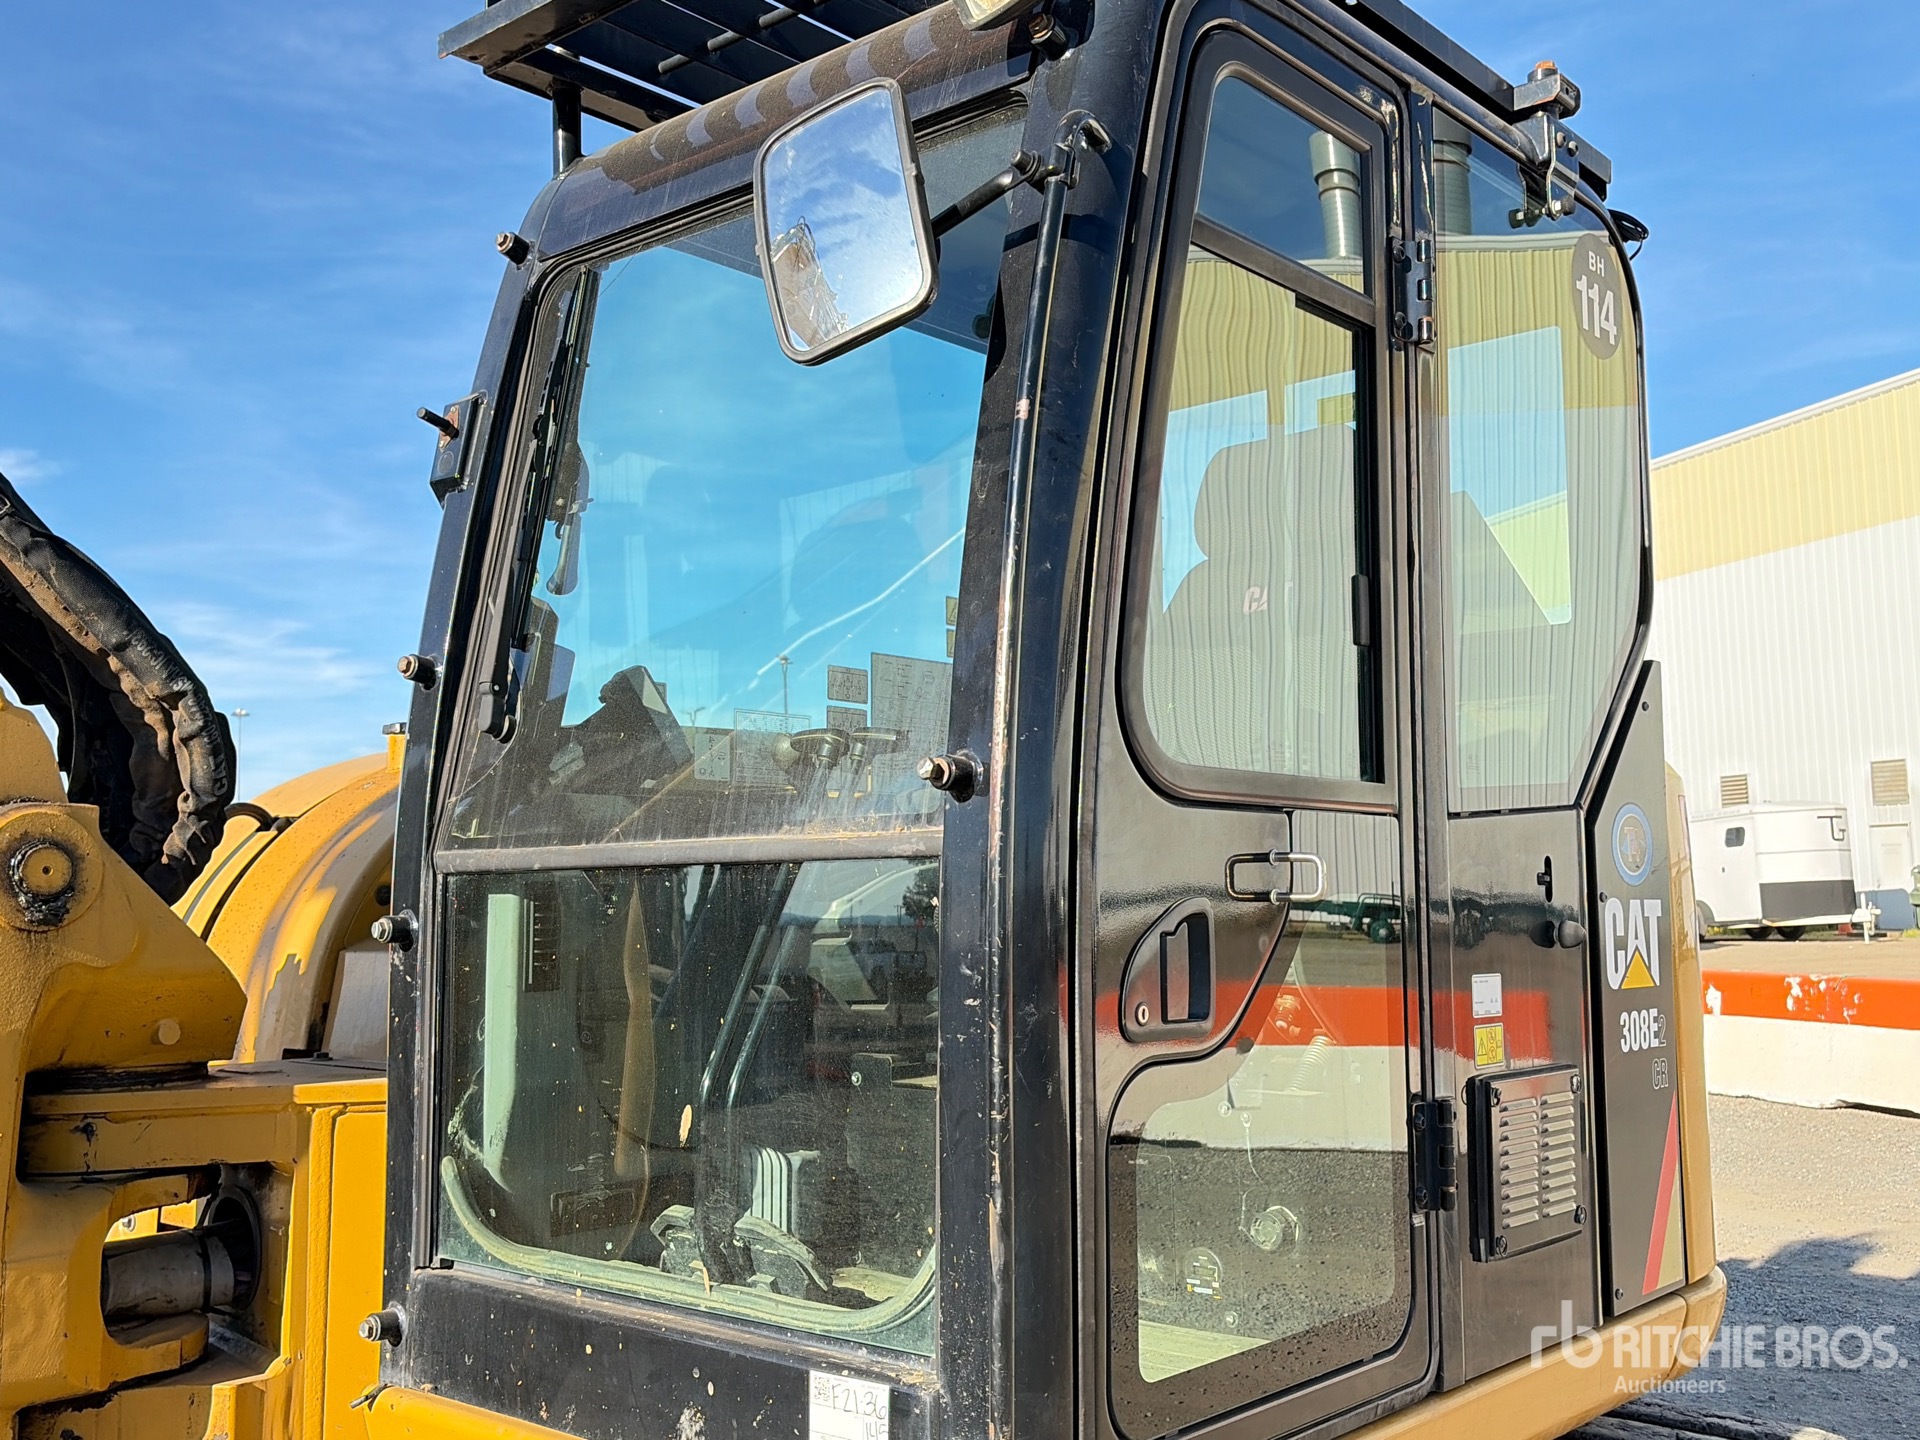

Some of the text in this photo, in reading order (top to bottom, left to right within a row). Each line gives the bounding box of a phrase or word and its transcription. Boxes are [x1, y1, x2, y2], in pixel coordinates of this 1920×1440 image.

[1588, 250, 1605, 277] BH
[1576, 274, 1617, 345] 114
[208, 752, 228, 796] CAT
[1604, 897, 1662, 990] CAT
[1620, 1008, 1667, 1053] 308E2
[1652, 1058, 1669, 1090] CR
